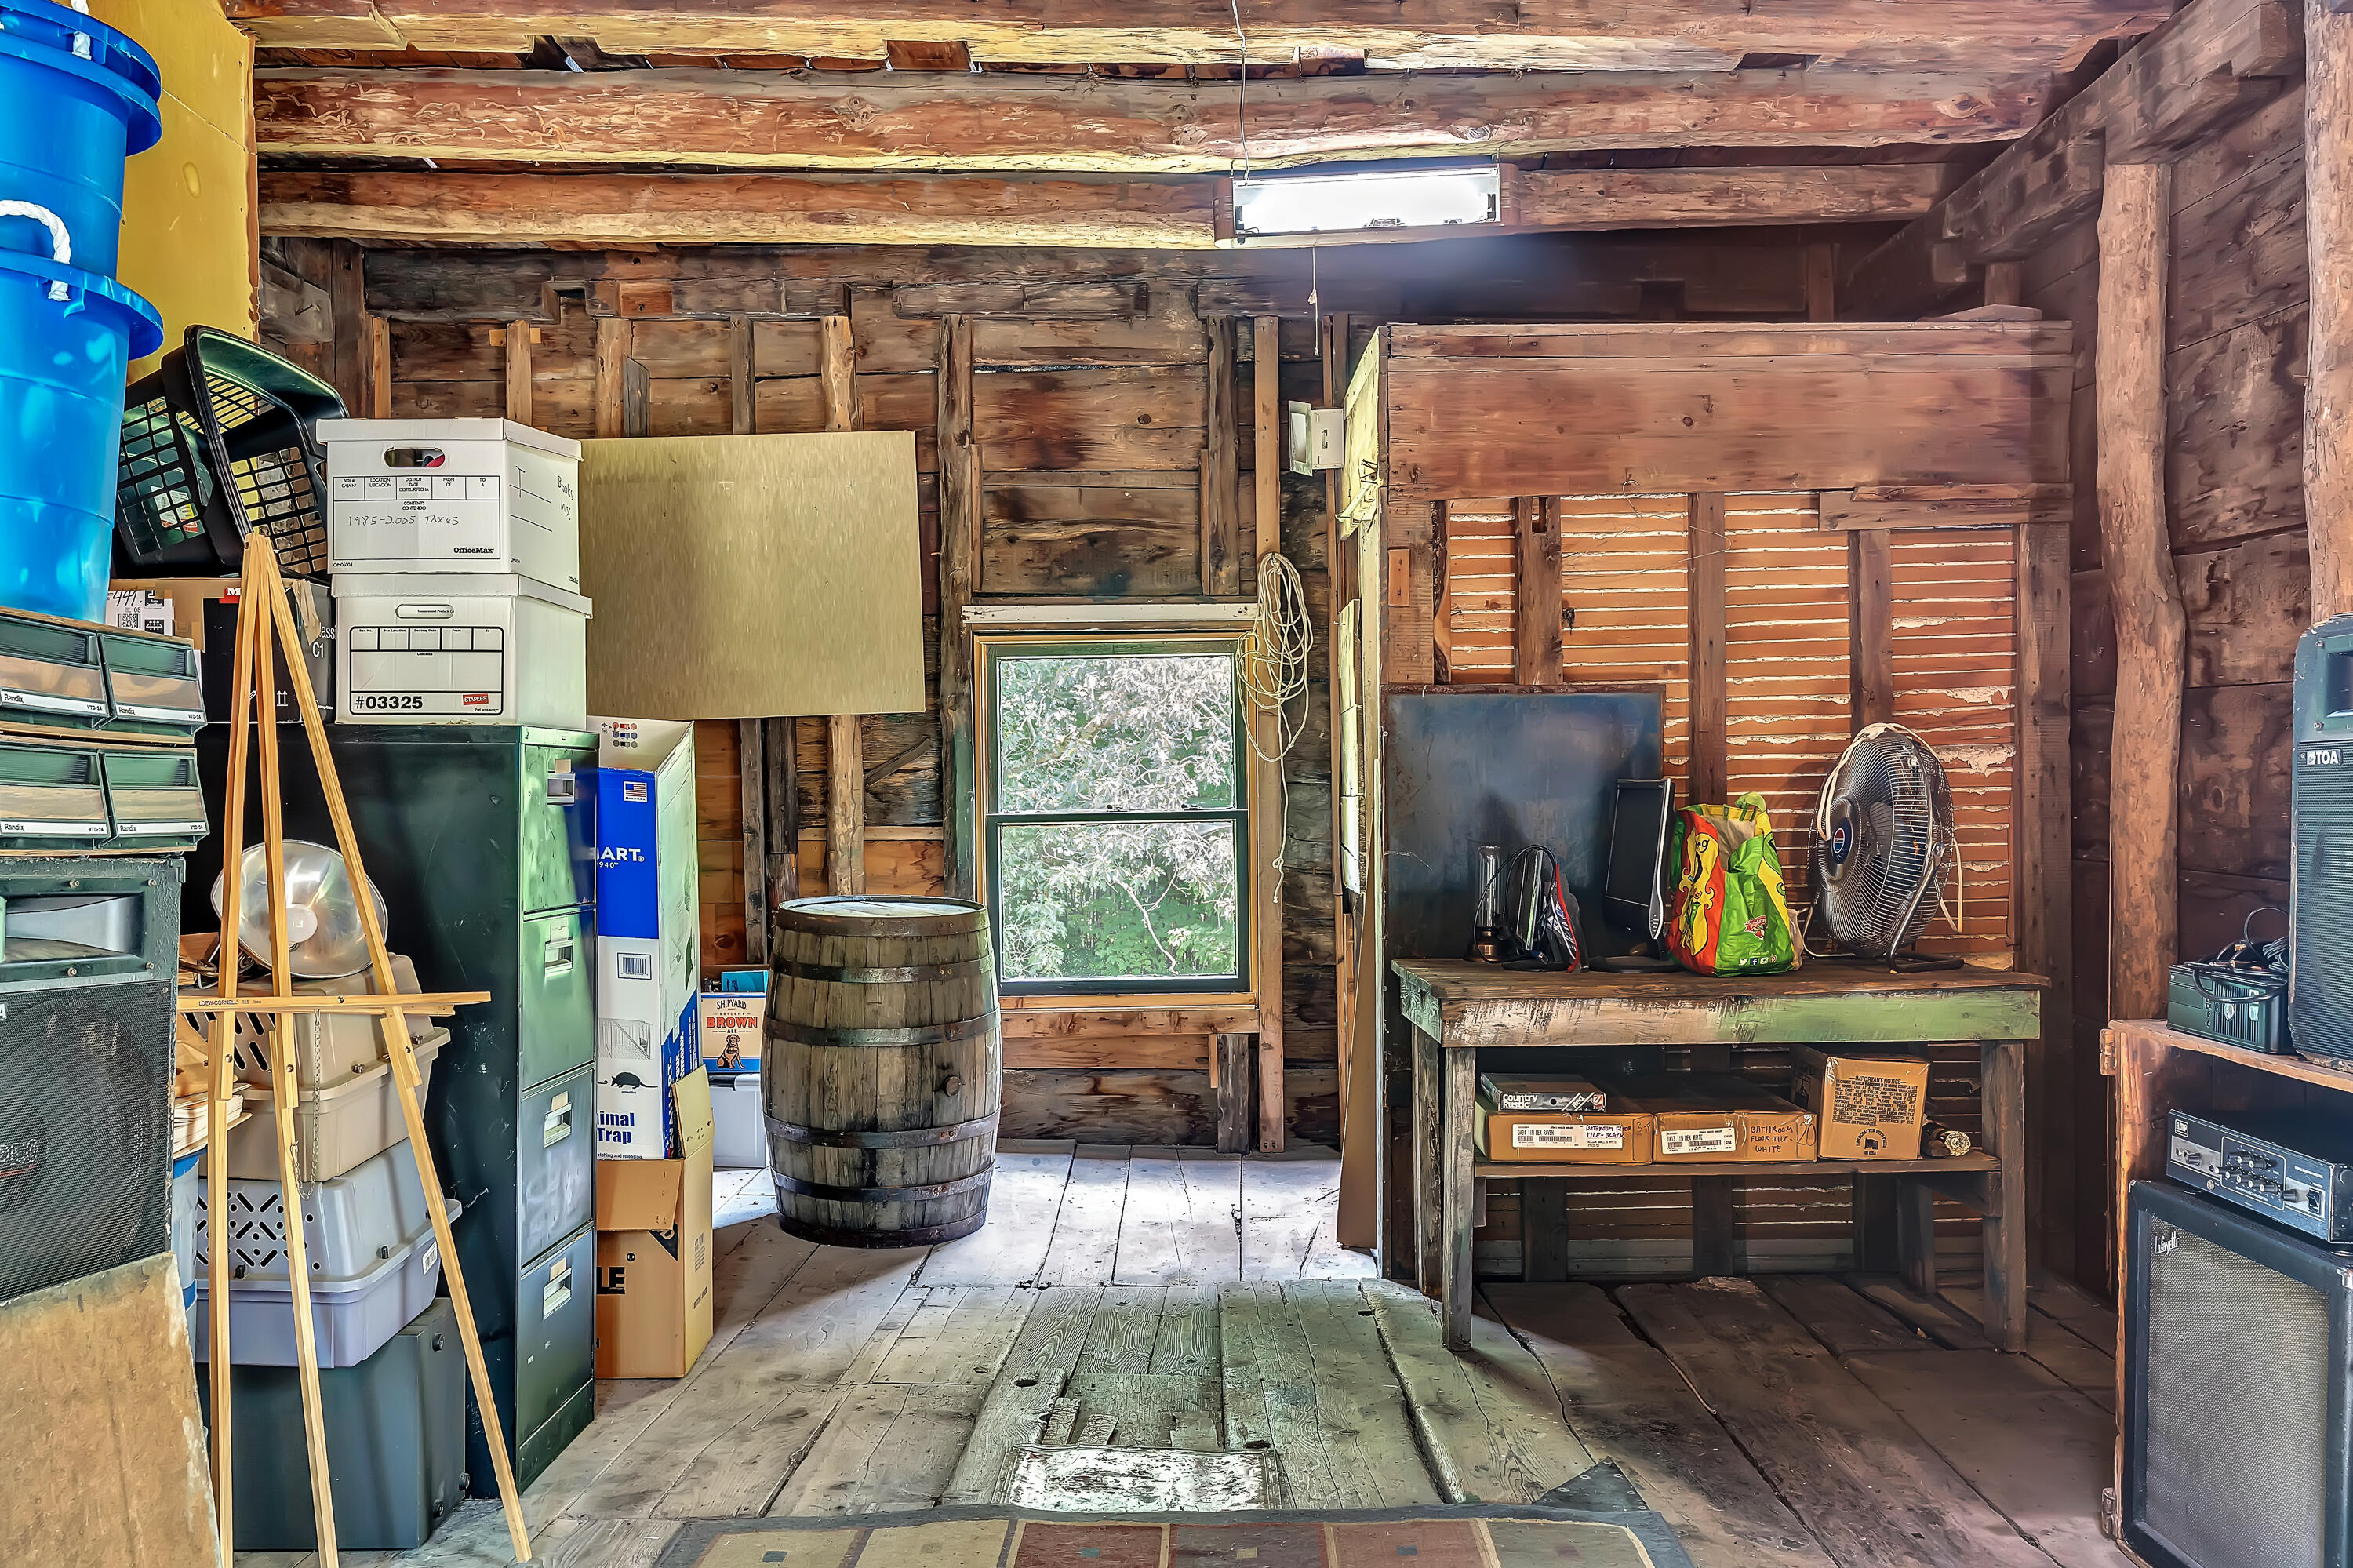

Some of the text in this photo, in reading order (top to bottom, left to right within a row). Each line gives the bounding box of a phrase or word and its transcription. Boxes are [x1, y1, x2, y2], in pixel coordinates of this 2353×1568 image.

[558, 475, 573, 501] Books
[425, 515, 460, 526] TAXES
[4, 693, 24, 704] Randix
[355, 696, 423, 709] #03325
[118, 707, 136, 715] Randix
[2315, 750, 2338, 765] TOA
[4, 824, 25, 832] Randix
[596, 847, 641, 862] ART
[716, 999, 747, 1010] SHIPYARD
[706, 1016, 758, 1028] BROWN
[1503, 1094, 1537, 1102] Country
[1571, 1095, 1585, 1108] Red
[597, 1128, 632, 1144] Trap
[1750, 1126, 1793, 1134] BATHROOM
[1797, 1122, 1816, 1146] 20
[1755, 1145, 1782, 1153] WHITE
[2155, 1231, 2180, 1255] Lafayette
